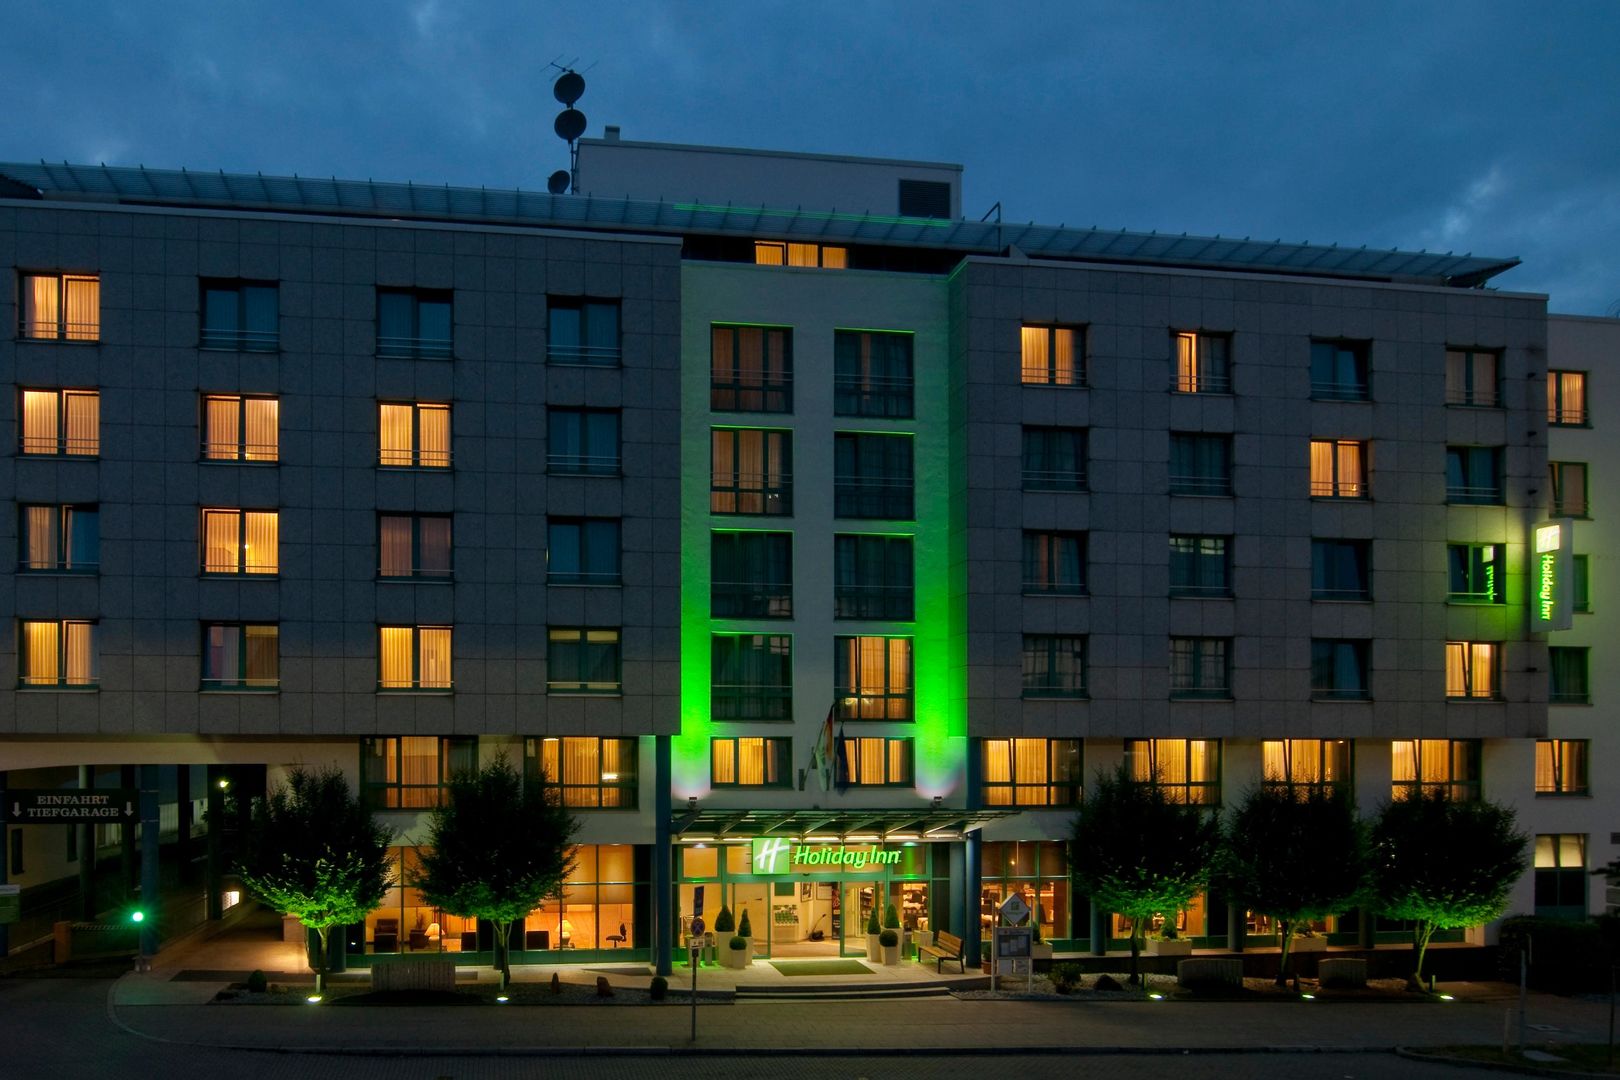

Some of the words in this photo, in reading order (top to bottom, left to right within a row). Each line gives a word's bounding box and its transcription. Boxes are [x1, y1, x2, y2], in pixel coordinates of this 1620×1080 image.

[1539, 554, 1554, 600] Holiday
[1541, 600, 1554, 620] Inn
[37, 795, 110, 805] EINFAHRT
[27, 807, 119, 817] TIEFGARAGE
[794, 845, 866, 869] Holiday
[869, 845, 901, 864] Inn
